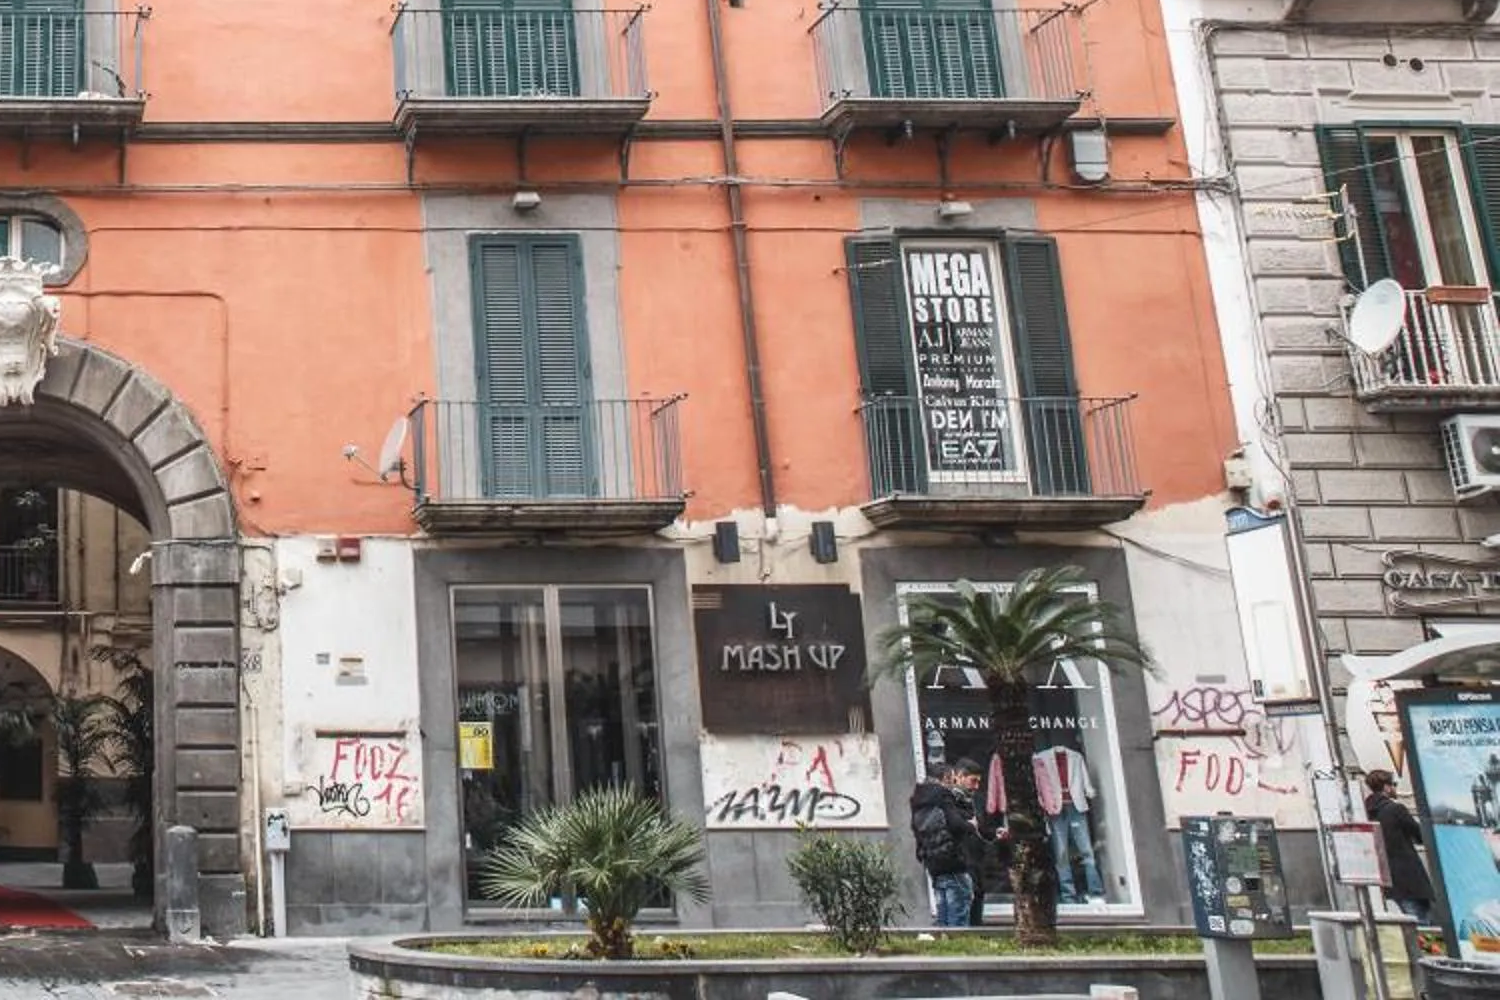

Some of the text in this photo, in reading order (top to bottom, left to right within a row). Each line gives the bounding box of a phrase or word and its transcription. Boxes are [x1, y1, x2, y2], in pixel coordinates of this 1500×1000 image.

[909, 253, 991, 296] MEGA
[915, 297, 994, 323] STORE
[919, 353, 997, 365] PREMIUM
[941, 440, 999, 459] EA7
[1384, 570, 1464, 589] CASA
[721, 644, 846, 671] MASH UP
[924, 716, 1099, 730] ARMAN CHANGE
